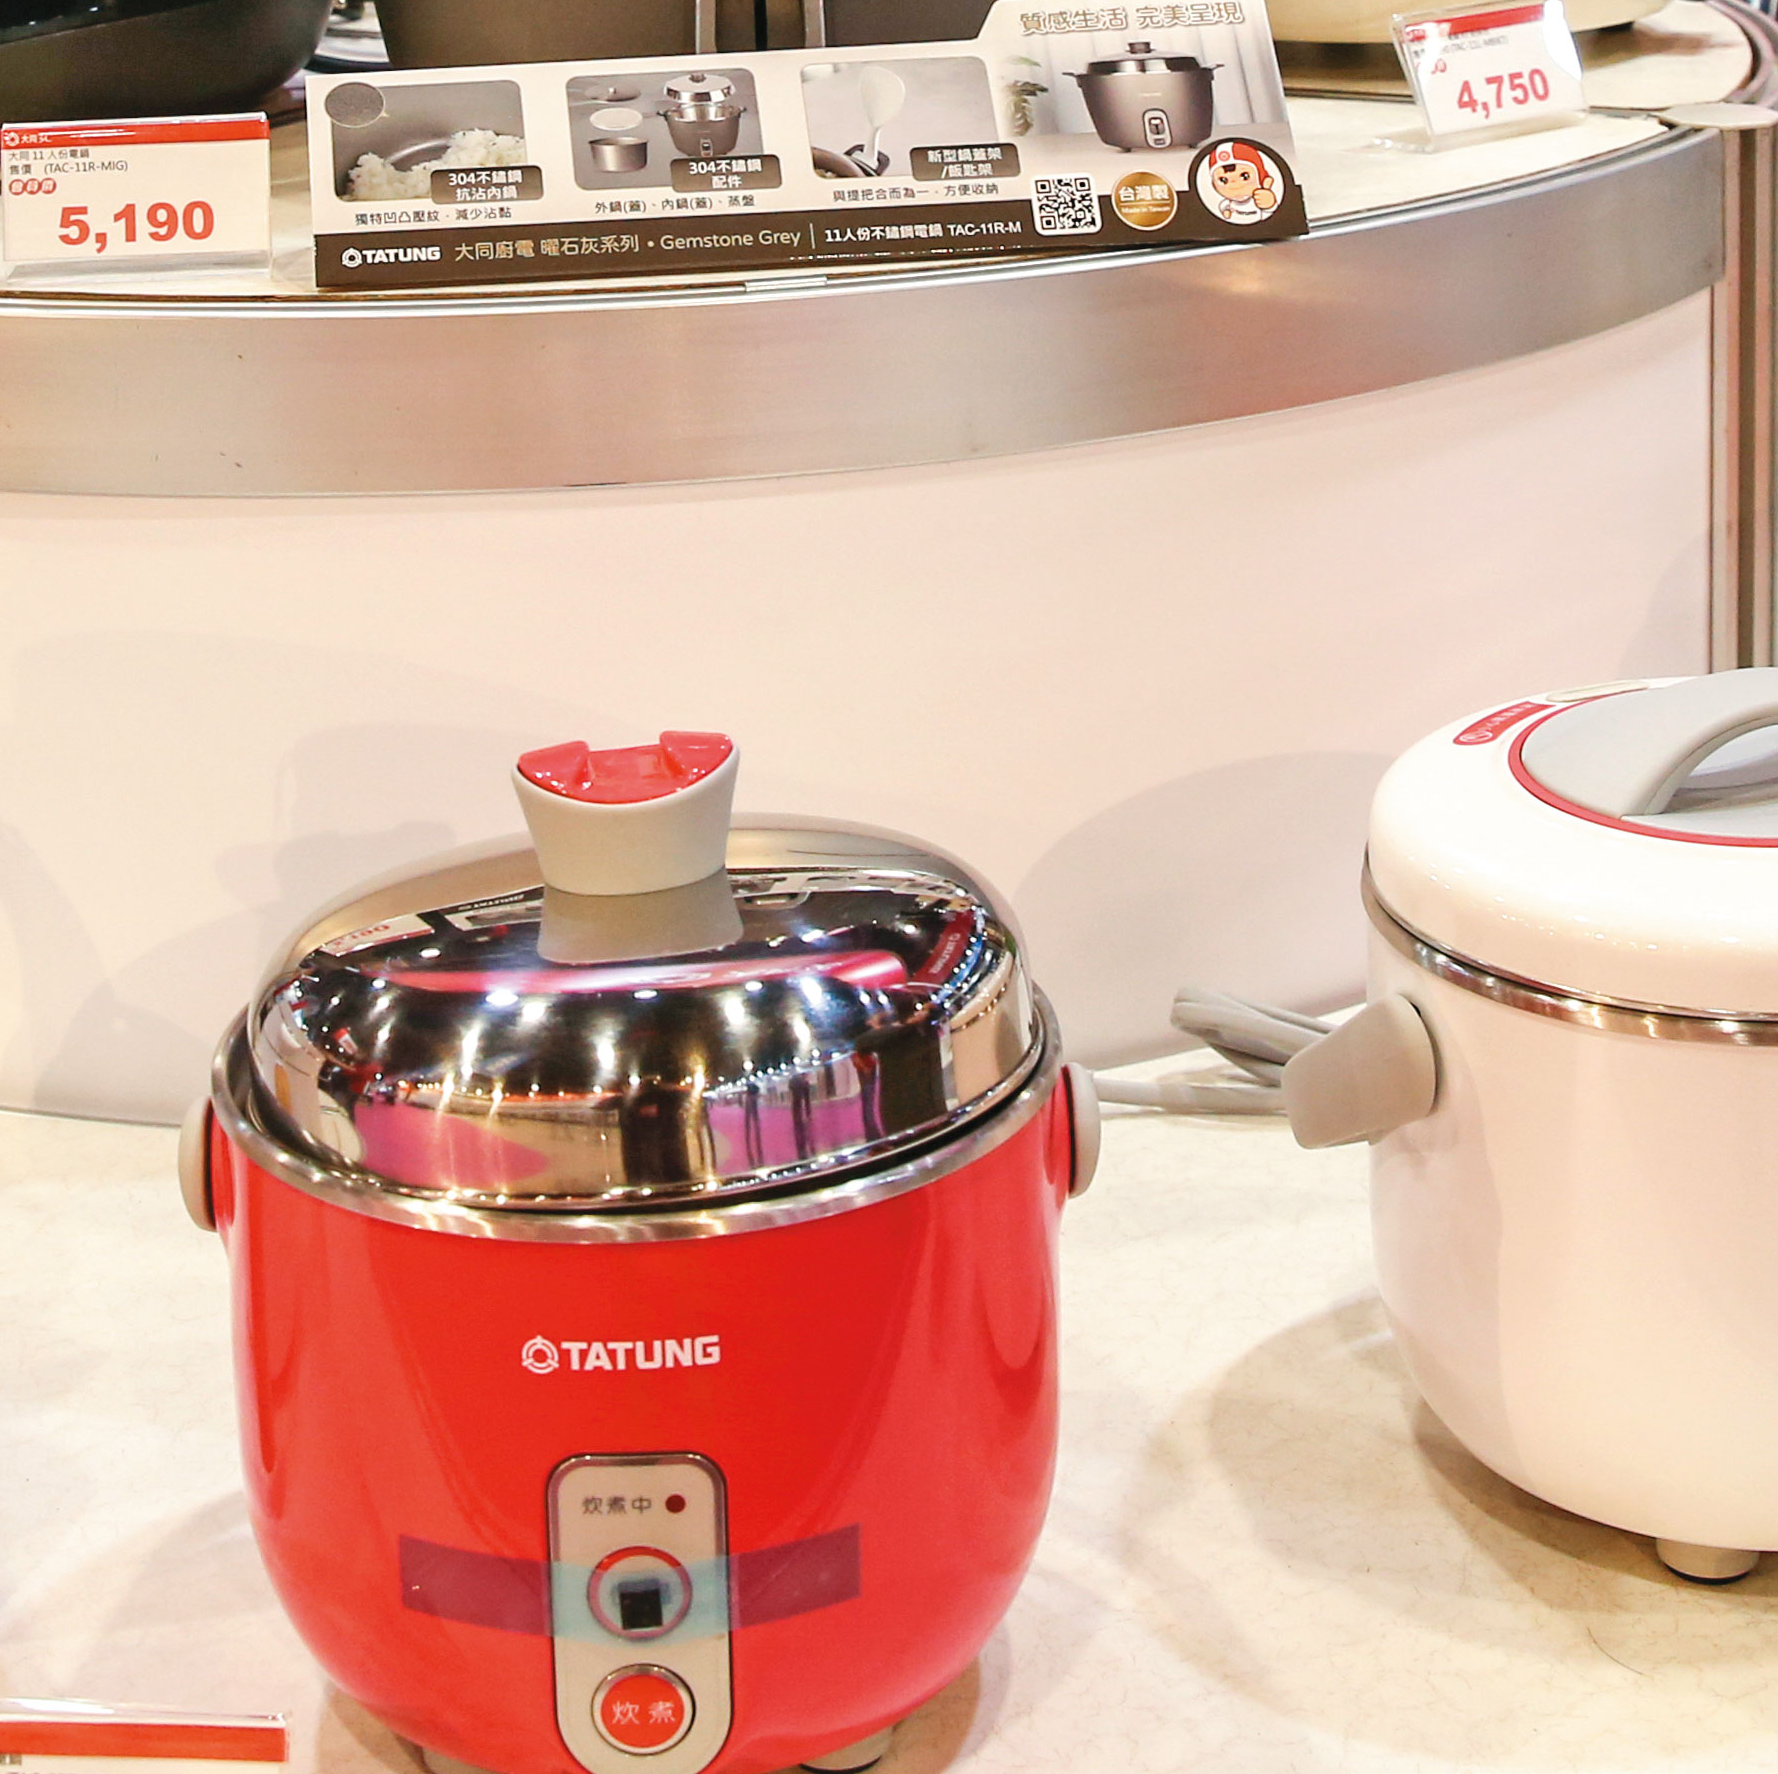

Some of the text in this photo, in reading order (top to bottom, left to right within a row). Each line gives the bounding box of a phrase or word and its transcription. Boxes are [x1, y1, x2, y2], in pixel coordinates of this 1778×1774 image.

[1020, 0, 1245, 35] 質感生活 完美呈現
[1457, 68, 1550, 119] 4,750
[32, 150, 45, 161] 11
[44, 160, 129, 176] (TAC-11R-MIG)
[711, 173, 743, 190] 配件
[58, 200, 215, 254] 5,190
[361, 246, 441, 264] TATUNG
[660, 230, 754, 250] Gemstone
[759, 228, 801, 249] Grey
[561, 1334, 722, 1371] TATUNG
[581, 1494, 653, 1516] 炊煮中
